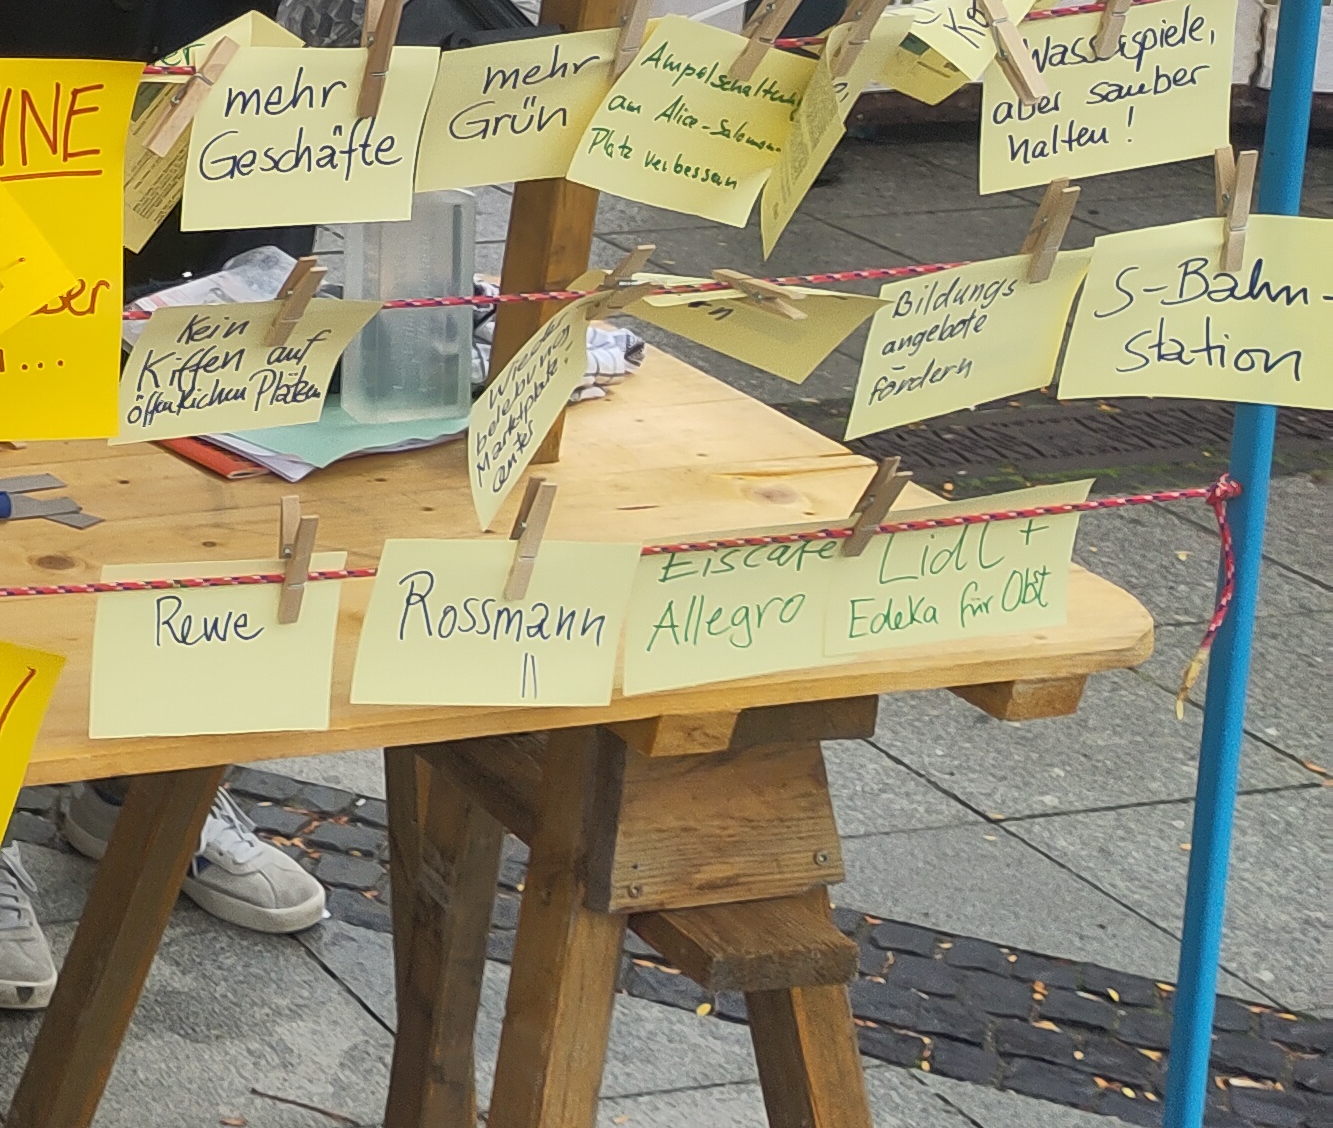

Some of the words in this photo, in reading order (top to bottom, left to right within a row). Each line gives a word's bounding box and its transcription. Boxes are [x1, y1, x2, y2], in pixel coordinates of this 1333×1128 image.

[224, 66, 347, 118] mehr
[482, 44, 601, 95] mehr
[1085, 64, 1210, 105] sauber
[449, 96, 568, 142] Grün
[587, 126, 633, 160] Platz
[1007, 119, 1109, 164] halten
[199, 116, 403, 181] Geschäfte
[892, 276, 1018, 319] Bildungs
[177, 313, 250, 345] Kein
[882, 309, 988, 357] angebote
[1116, 316, 1302, 381] Station
[137, 345, 245, 393] Kiffen
[266, 329, 332, 366] auf
[877, 520, 1005, 585] Lidl
[155, 595, 265, 647] Rewe
[399, 570, 607, 647] Rossmann
[647, 592, 806, 652] Allegro
[848, 593, 939, 639] Edeka
[960, 580, 990, 628] für
[1001, 565, 1052, 613] Obst
